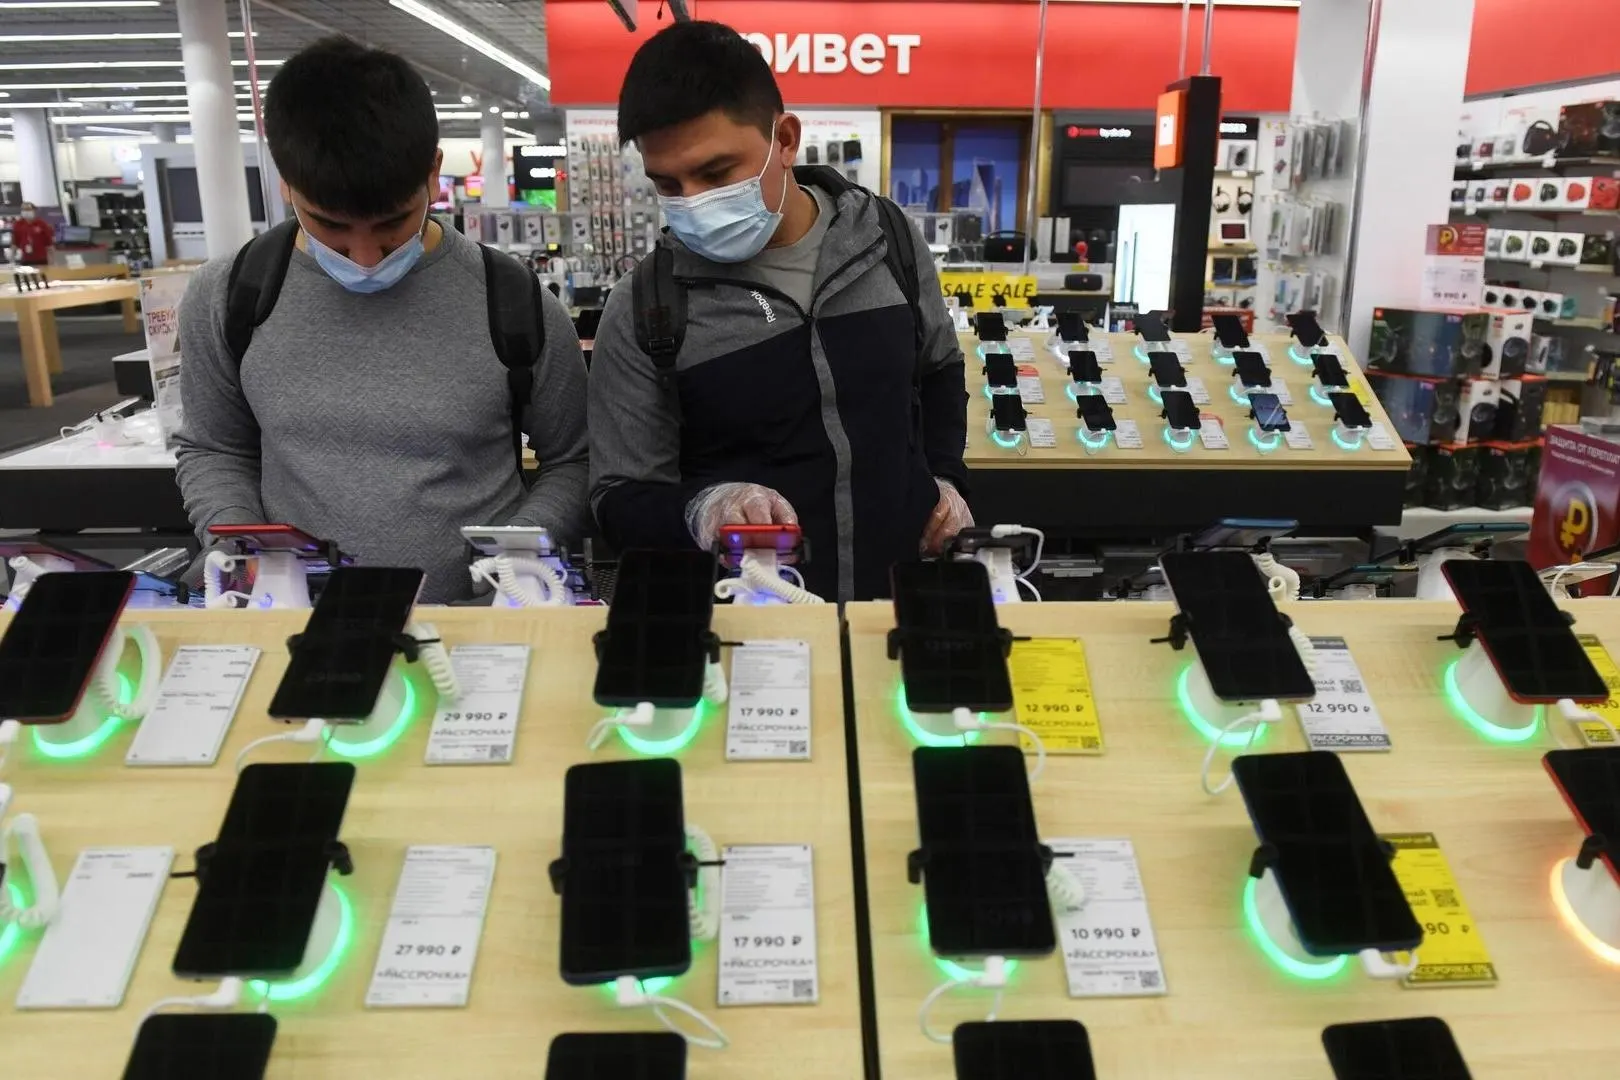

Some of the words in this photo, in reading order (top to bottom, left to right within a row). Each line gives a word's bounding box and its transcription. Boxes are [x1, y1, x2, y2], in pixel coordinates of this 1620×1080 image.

[991, 283, 1034, 298] SALE
[750, 289, 776, 323] Reebok
[740, 707, 753, 717] 17
[757, 707, 784, 716] 990
[1025, 704, 1039, 713] 12
[1043, 704, 1070, 713] 990
[1307, 703, 1324, 713] 12
[1327, 703, 1358, 713] 990
[444, 712, 461, 722] 29
[465, 712, 492, 721] 990
[1071, 928, 1089, 939] 10
[1093, 928, 1124, 939] 990
[733, 936, 749, 948] 17
[753, 936, 785, 947] 990
[394, 944, 413, 956] 27
[416, 945, 445, 956] 990
